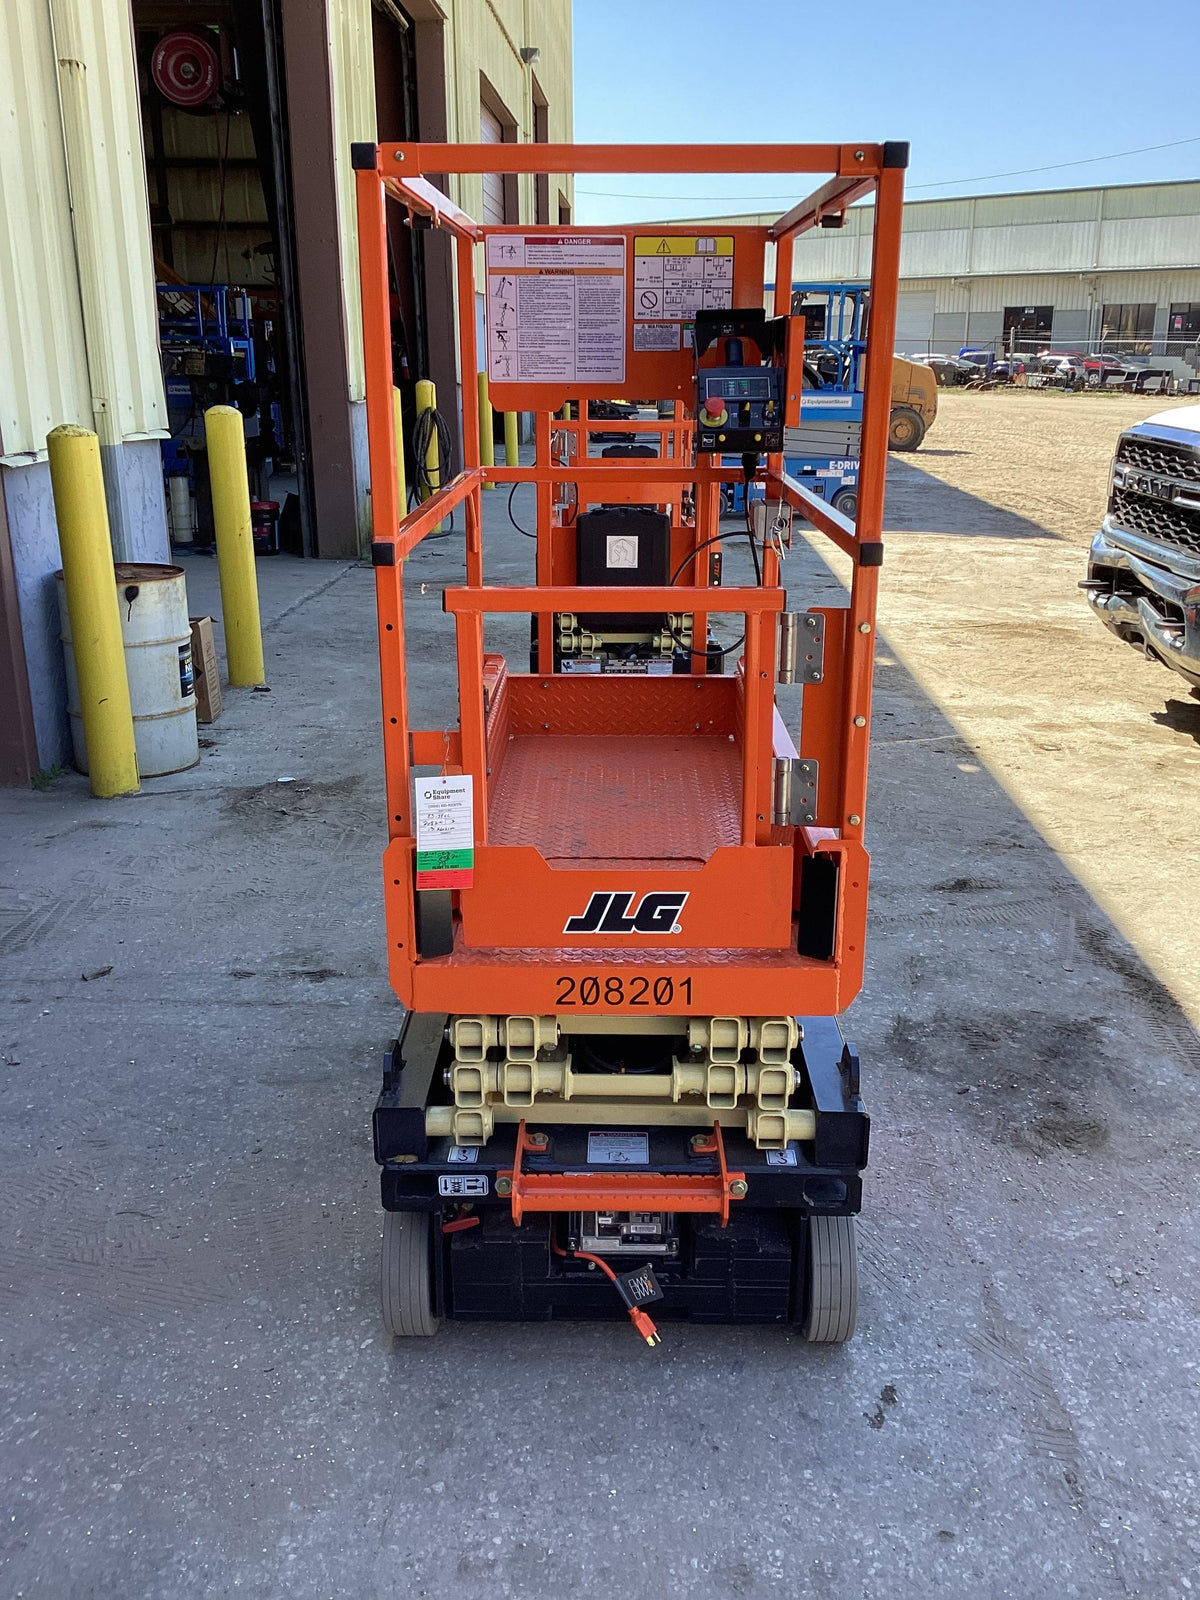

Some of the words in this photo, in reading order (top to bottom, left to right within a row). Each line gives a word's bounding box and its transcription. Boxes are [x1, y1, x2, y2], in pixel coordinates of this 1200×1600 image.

[829, 460, 860, 470] E-DRIV
[1126, 473, 1170, 498] RAM
[562, 891, 690, 934] JLG
[555, 976, 692, 1006] 208201
